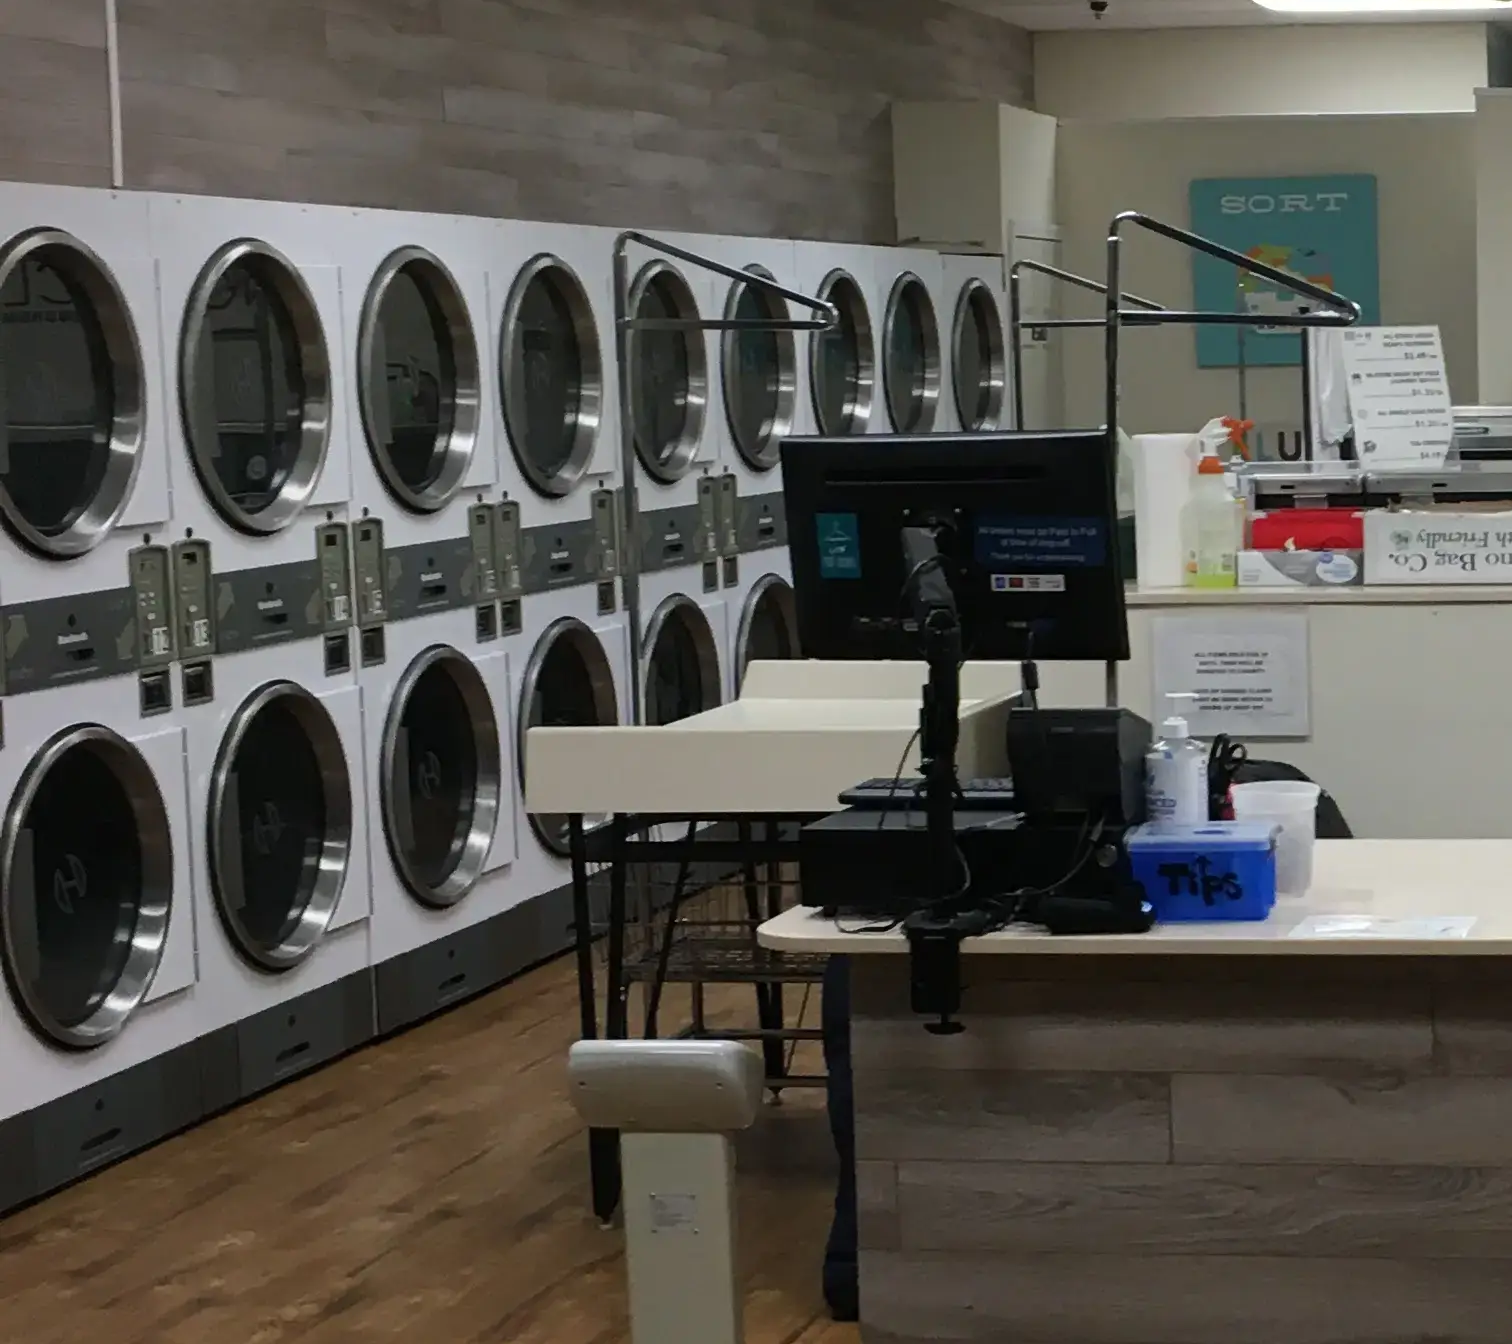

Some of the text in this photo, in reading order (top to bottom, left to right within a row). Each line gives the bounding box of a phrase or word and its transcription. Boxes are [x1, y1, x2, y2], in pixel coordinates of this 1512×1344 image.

[1219, 191, 1349, 215] SORT
[1416, 529, 1489, 549] Friendly
[1387, 552, 1428, 572] Co.
[1434, 551, 1477, 572] Bag
[1156, 861, 1244, 907] Tips
